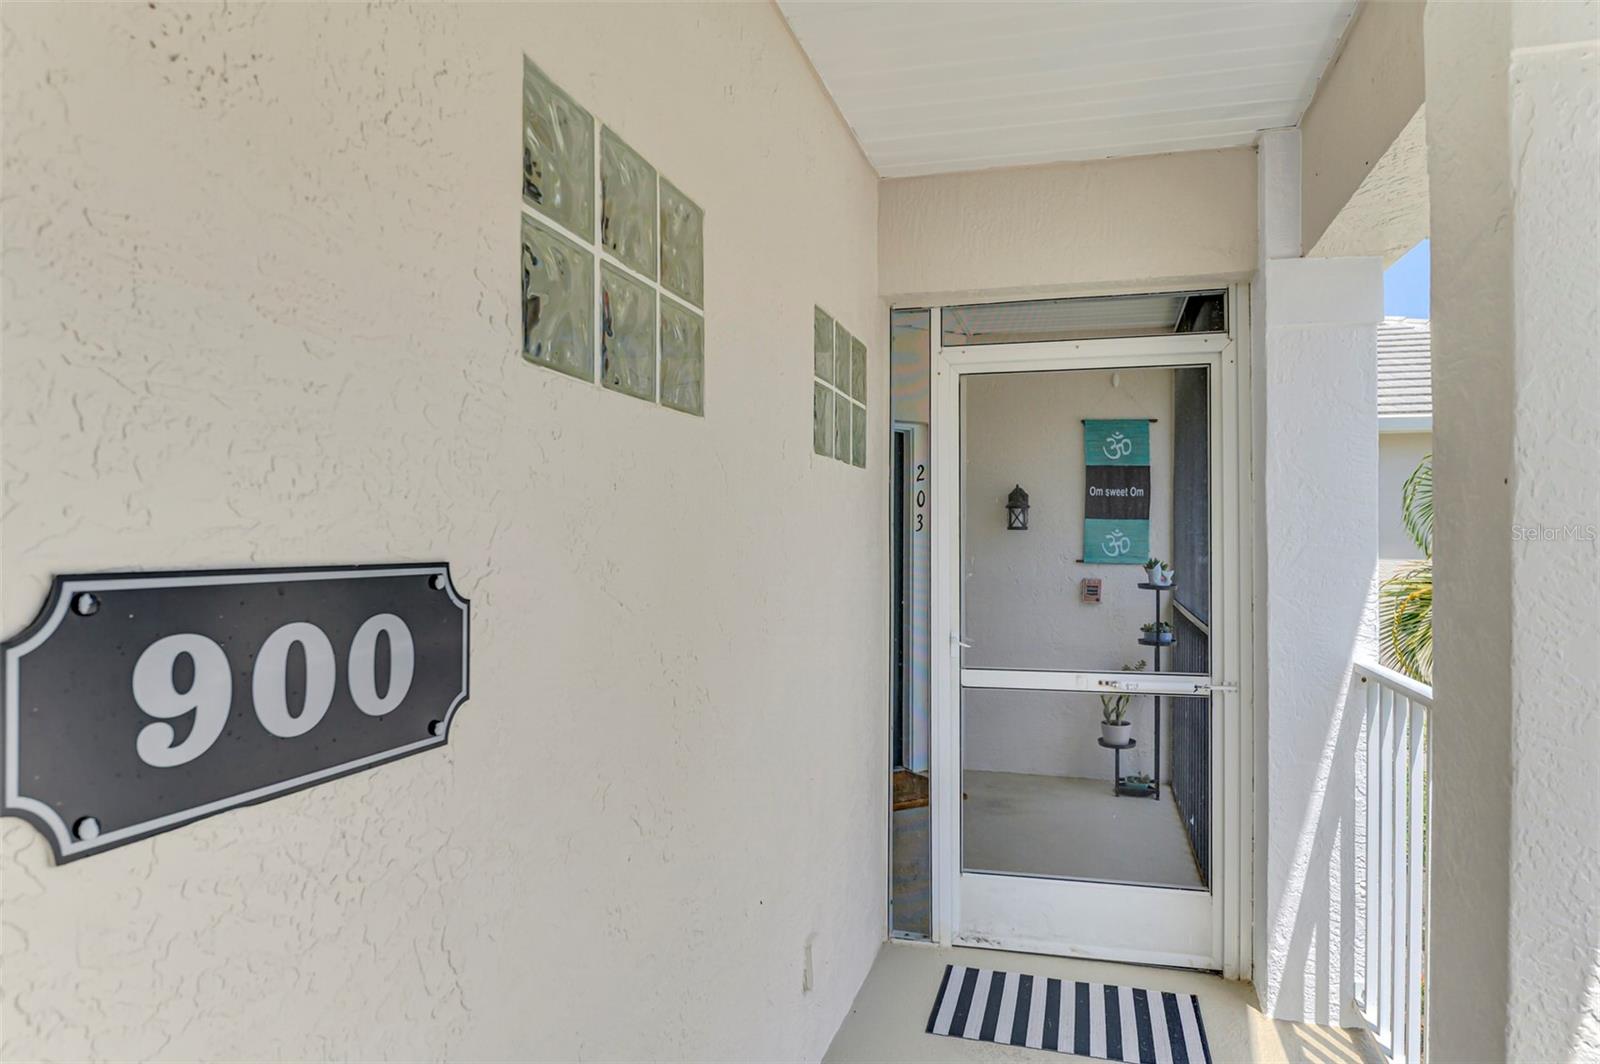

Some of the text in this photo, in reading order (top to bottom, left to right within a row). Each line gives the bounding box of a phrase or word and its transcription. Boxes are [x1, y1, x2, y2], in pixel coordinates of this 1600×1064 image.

[915, 464, 926, 532] 203
[1089, 486, 1145, 497] Om sweet Om
[132, 612, 415, 768] 900
